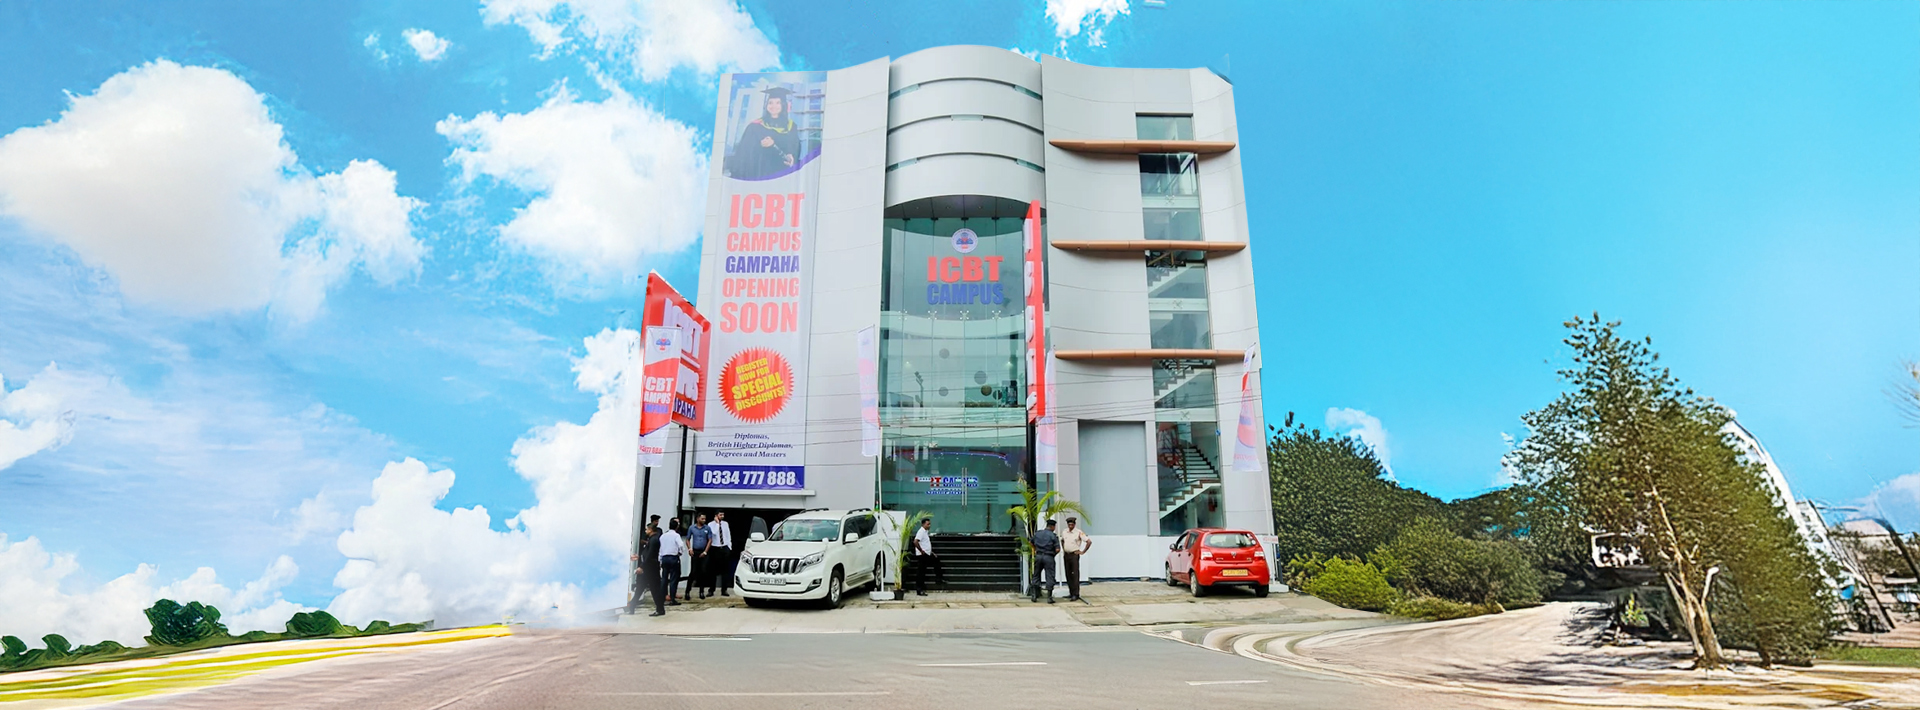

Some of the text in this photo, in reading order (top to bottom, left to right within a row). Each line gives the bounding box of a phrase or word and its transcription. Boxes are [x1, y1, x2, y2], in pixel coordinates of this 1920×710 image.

[729, 193, 805, 229] ICBT
[726, 231, 802, 252] CAMPUS
[725, 255, 800, 273] GAMPAHA
[928, 256, 1003, 283] ICBT
[722, 277, 799, 298] OPENING
[927, 283, 1004, 304] CAMPUS
[719, 301, 798, 333] SOON
[731, 371, 784, 400] SPECIAL
[735, 385, 787, 411] DISCOUNTS!
[707, 441, 794, 450] British Higher Diplomas,
[715, 450, 742, 458] Degrees
[702, 470, 796, 486] 0334 777 888
